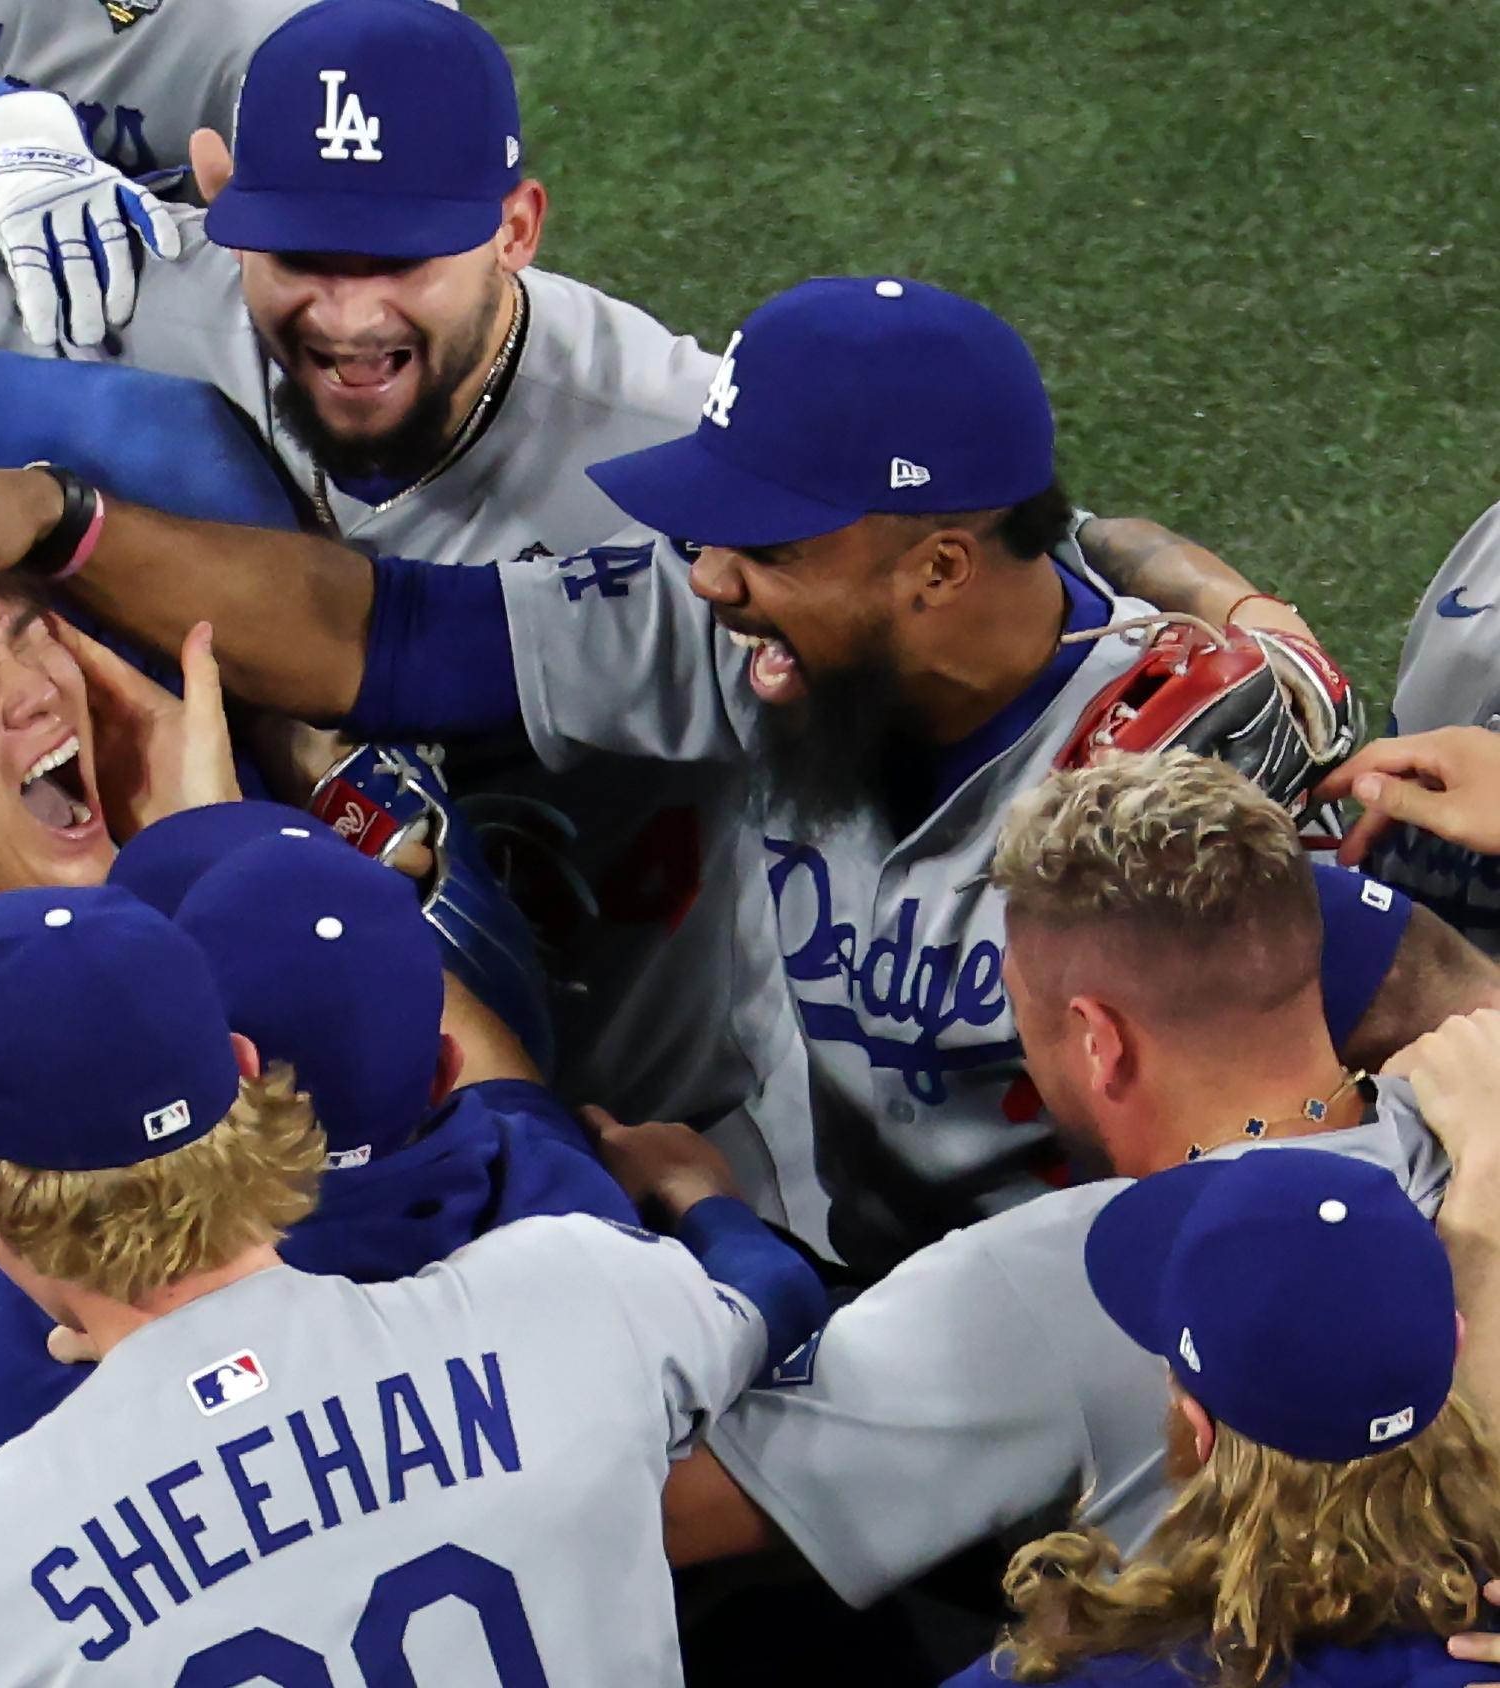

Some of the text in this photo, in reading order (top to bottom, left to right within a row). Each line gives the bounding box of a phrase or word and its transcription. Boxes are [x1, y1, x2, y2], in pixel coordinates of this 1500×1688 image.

[315, 69, 383, 161] LA
[702, 330, 743, 429] LA
[764, 835, 1007, 1106] Dodge
[30, 1351, 523, 1662] SHEEHAN
